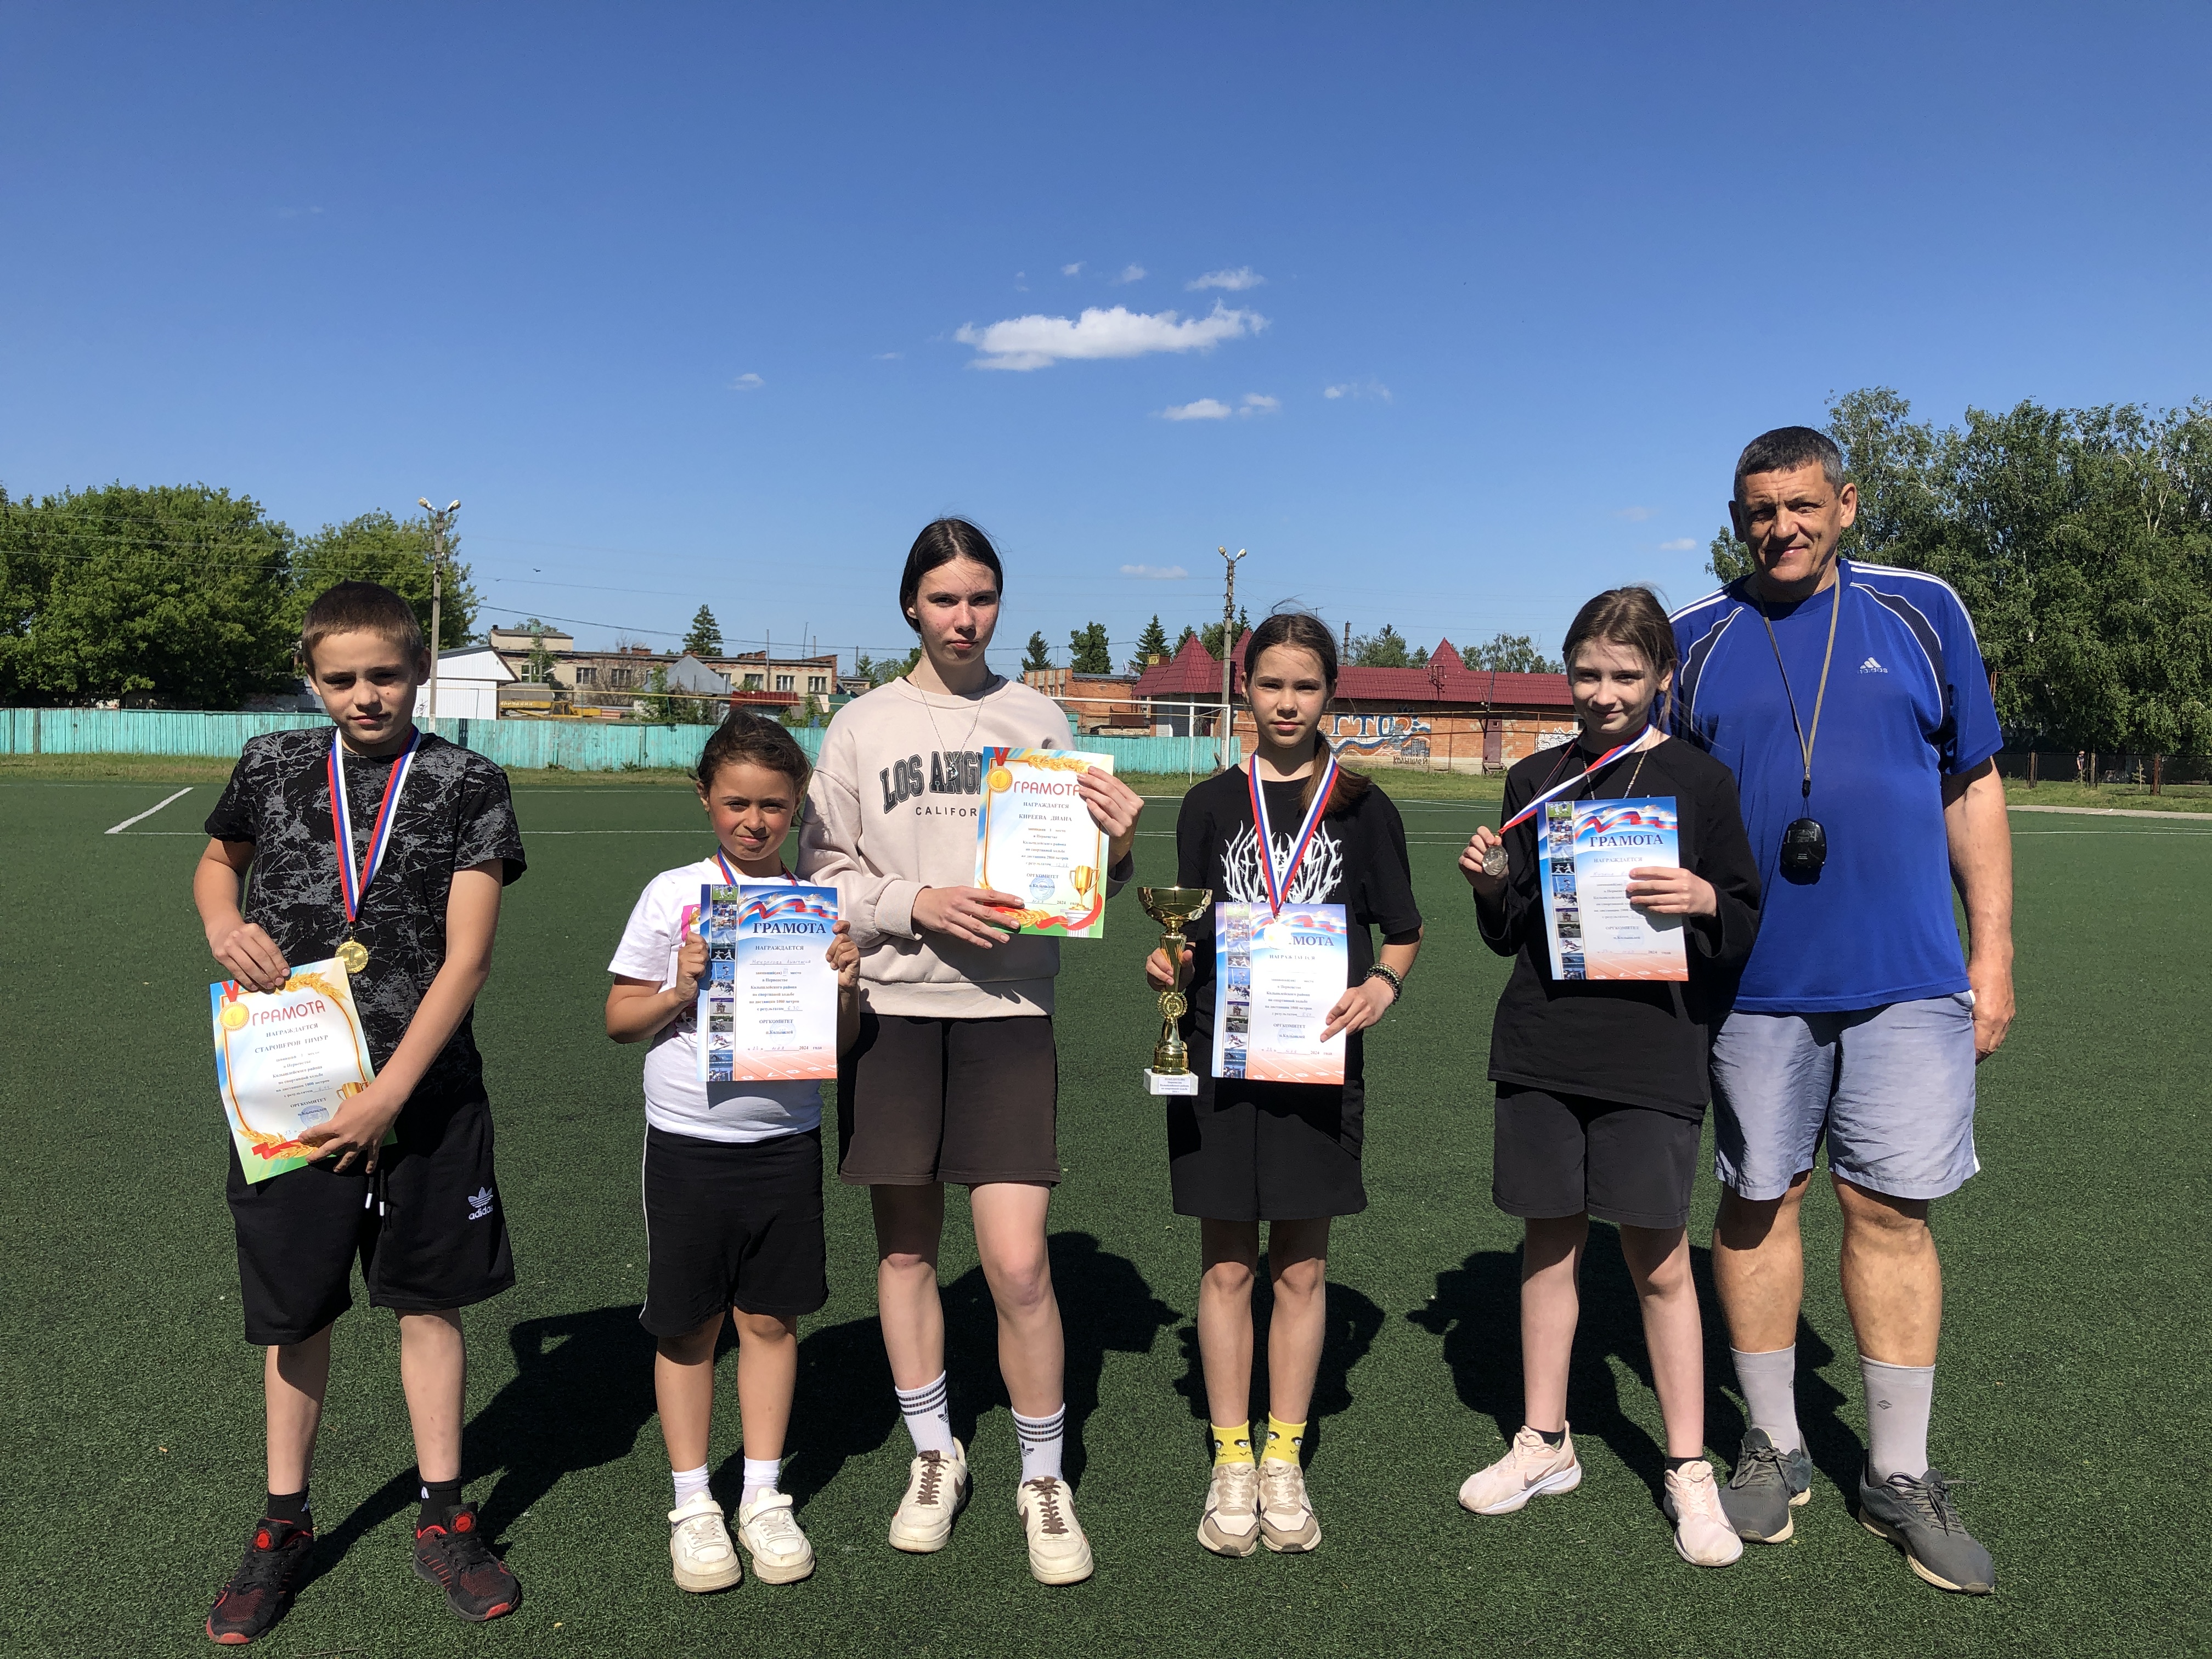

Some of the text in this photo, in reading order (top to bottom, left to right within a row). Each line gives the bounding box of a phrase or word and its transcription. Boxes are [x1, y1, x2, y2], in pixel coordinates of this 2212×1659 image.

[1330, 714, 1396, 737] ГТО
[879, 754, 924, 814] LOS
[916, 806, 977, 817] CALIFOR
[1589, 834, 1664, 847] ГРАМОТА
[752, 923, 827, 933] ГРАМОТА
[1289, 936, 1334, 946] МОТА
[252, 1000, 326, 1026] ГРАМОТА
[266, 1023, 318, 1037] НАГРАЖДАЕТСЯ
[255, 1035, 328, 1053] СТАРОВЕРОВ ТИМУР
[290, 1098, 326, 1108] ОРГКОМИТЕТ
[468, 1205, 493, 1220] adidas
